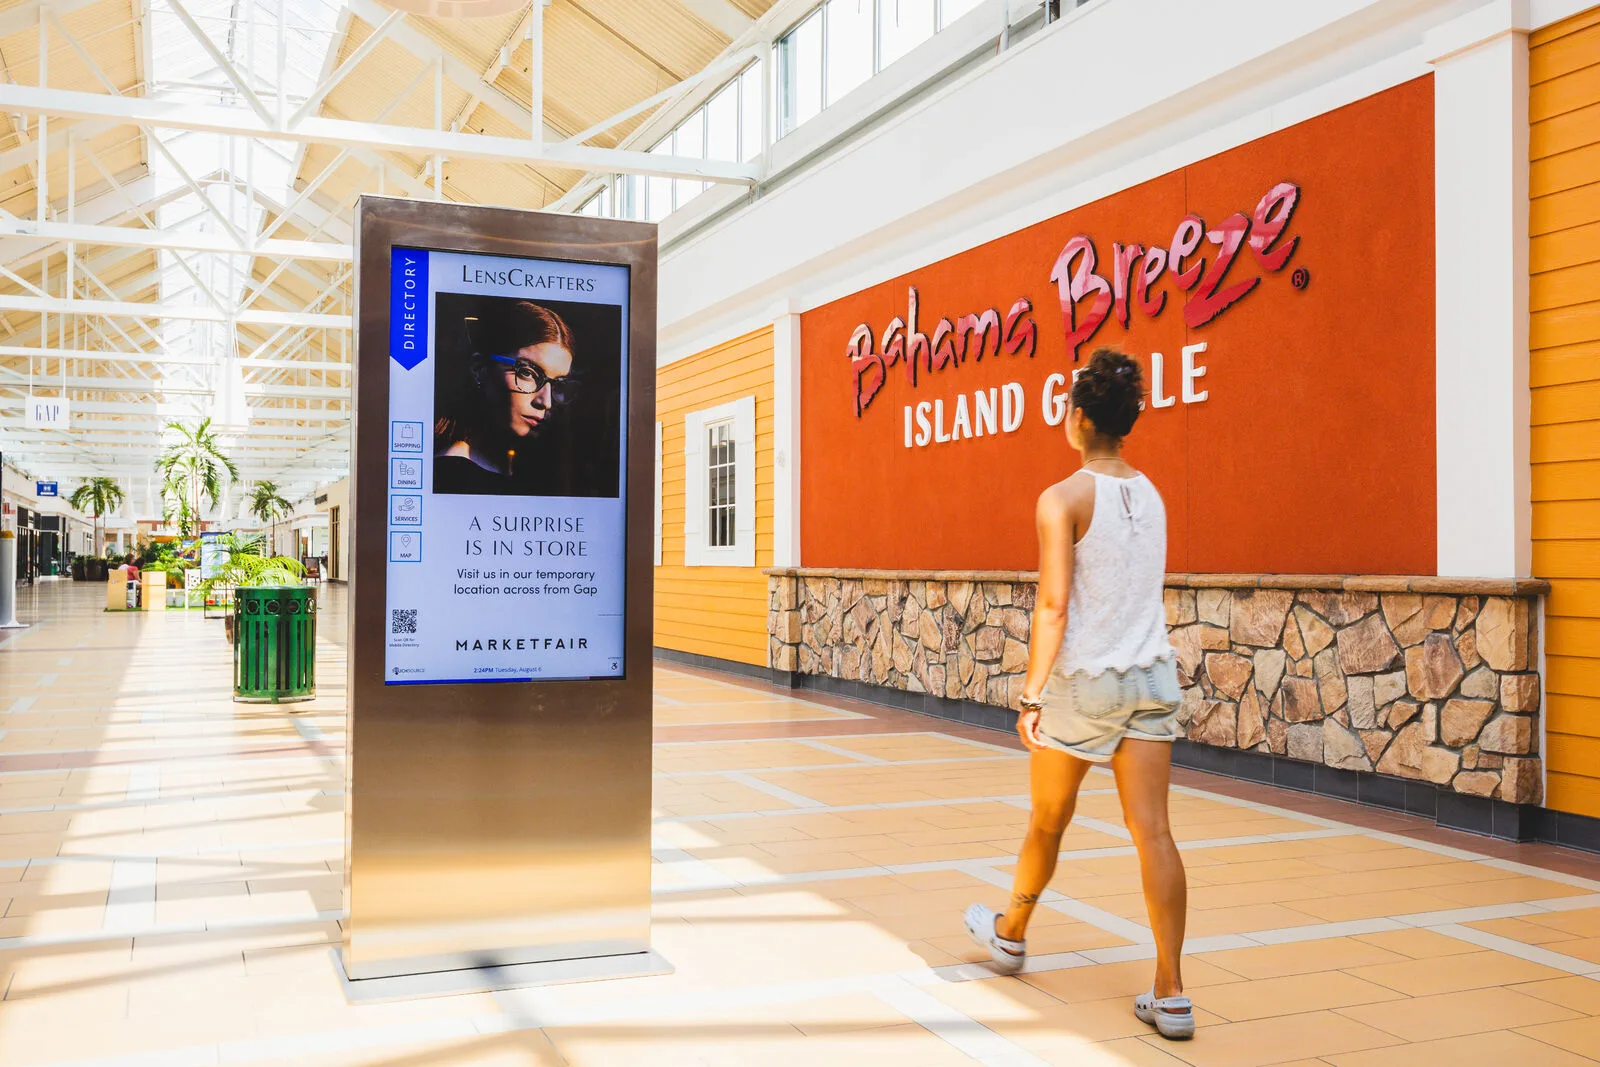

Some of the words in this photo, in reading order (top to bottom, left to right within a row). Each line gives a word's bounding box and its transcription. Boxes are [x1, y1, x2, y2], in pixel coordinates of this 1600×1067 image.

[403, 257, 417, 350] DIRECTORY
[846, 286, 1037, 417] Bahama
[1050, 181, 1301, 361] Breeze
[904, 382, 1025, 448] ISLAND
[1041, 341, 1209, 426] GLE
[35, 404, 59, 421] GAP
[469, 516, 482, 531] A
[492, 516, 585, 533] SURPRISE
[466, 540, 482, 556] IS
[493, 540, 513, 556] IN
[523, 540, 588, 557] STORE
[457, 568, 480, 579] Visit
[483, 571, 496, 579] us
[500, 569, 510, 579] in
[513, 571, 532, 580] our
[536, 570, 595, 582] temporary
[454, 584, 500, 595] location
[503, 586, 540, 595] across
[543, 584, 570, 595] from
[573, 585, 598, 597] Gap
[455, 638, 588, 651] MARKETFAIR
